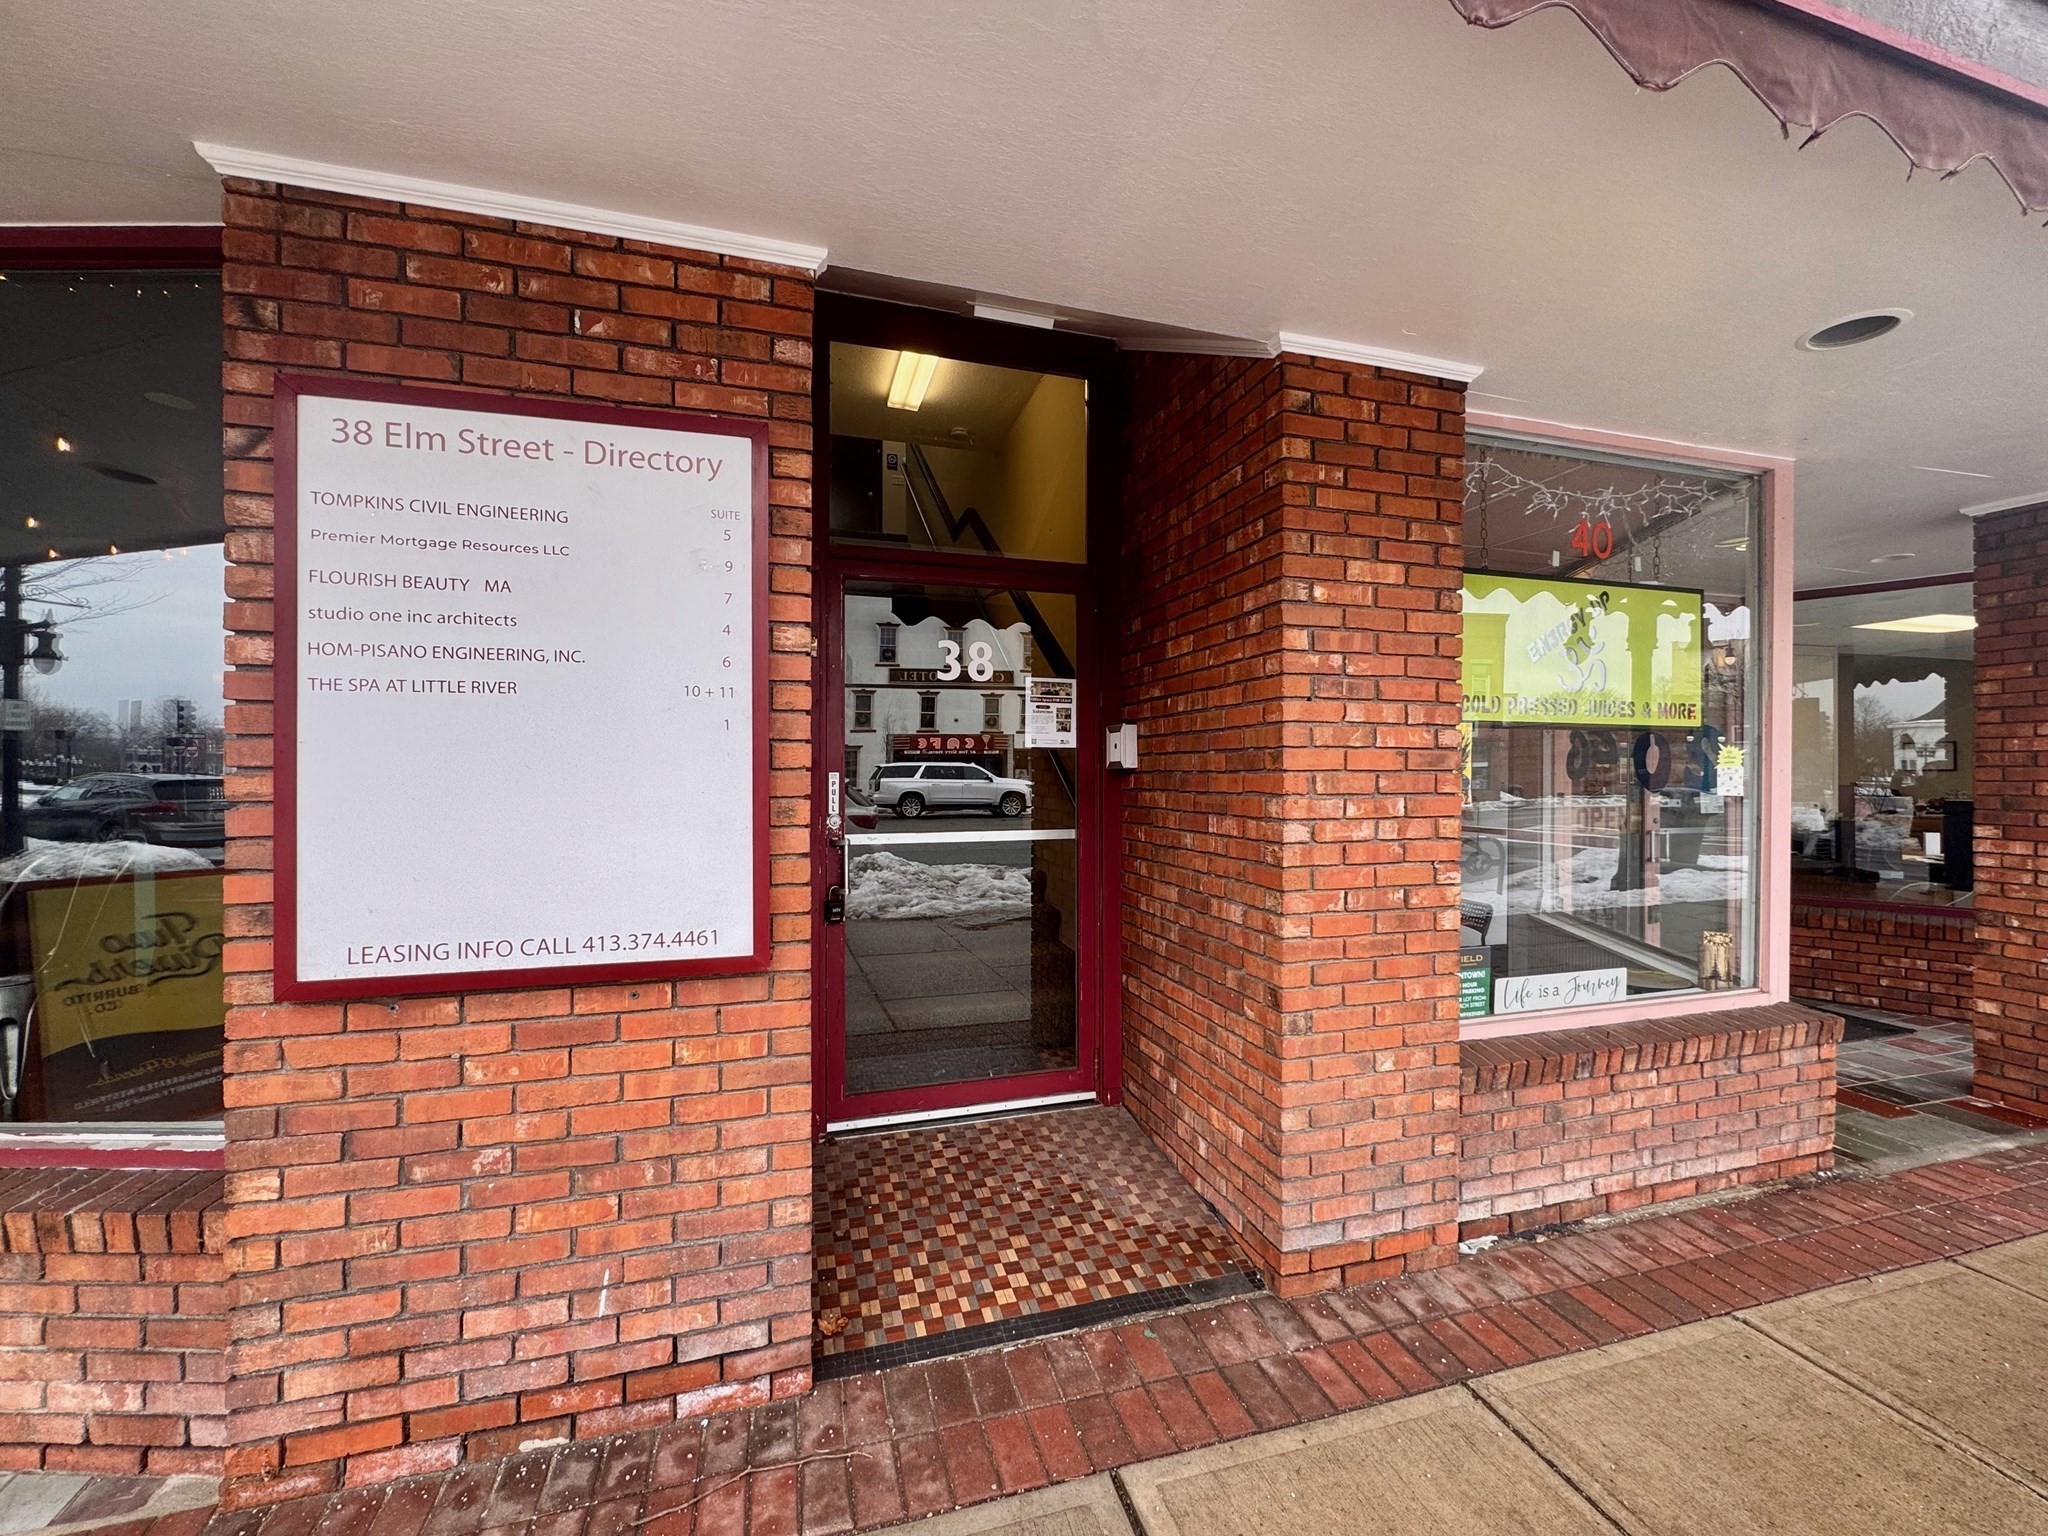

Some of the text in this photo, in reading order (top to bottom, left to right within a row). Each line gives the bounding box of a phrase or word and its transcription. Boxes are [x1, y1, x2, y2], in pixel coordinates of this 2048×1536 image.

[331, 417, 374, 446] 38
[385, 421, 446, 452] Elm
[457, 428, 555, 462] Street
[584, 440, 724, 482] Directory
[309, 490, 569, 524] TOMPKINS CIVIL ENGINEERING
[710, 508, 741, 521] SUITE
[310, 528, 570, 557] Premier Mortgage Resources LLC
[722, 529, 732, 542] 5
[1571, 518, 1613, 559] 40
[724, 560, 734, 573] 9
[309, 569, 512, 594] FLOURISH BEAUTY MA
[723, 592, 733, 605] 7
[308, 606, 518, 627] studio one inc architects
[721, 624, 732, 636] 4
[307, 641, 586, 665] HOM-PISANO ENGINEERING, INC.
[722, 655, 732, 669] 6
[936, 640, 994, 682] 38
[306, 677, 517, 695] THE SPA AT LITTLE RIVER
[684, 685, 734, 699] 10 + 11
[1461, 694, 1697, 720] COLD PRESSED JUICES & MORE
[724, 718, 729, 731] 1
[347, 929, 718, 965] LEASING INFO CALL 413.374.4461
[1460, 954, 1483, 963] IELD
[1503, 975, 1621, 1010] Life is a Journey
